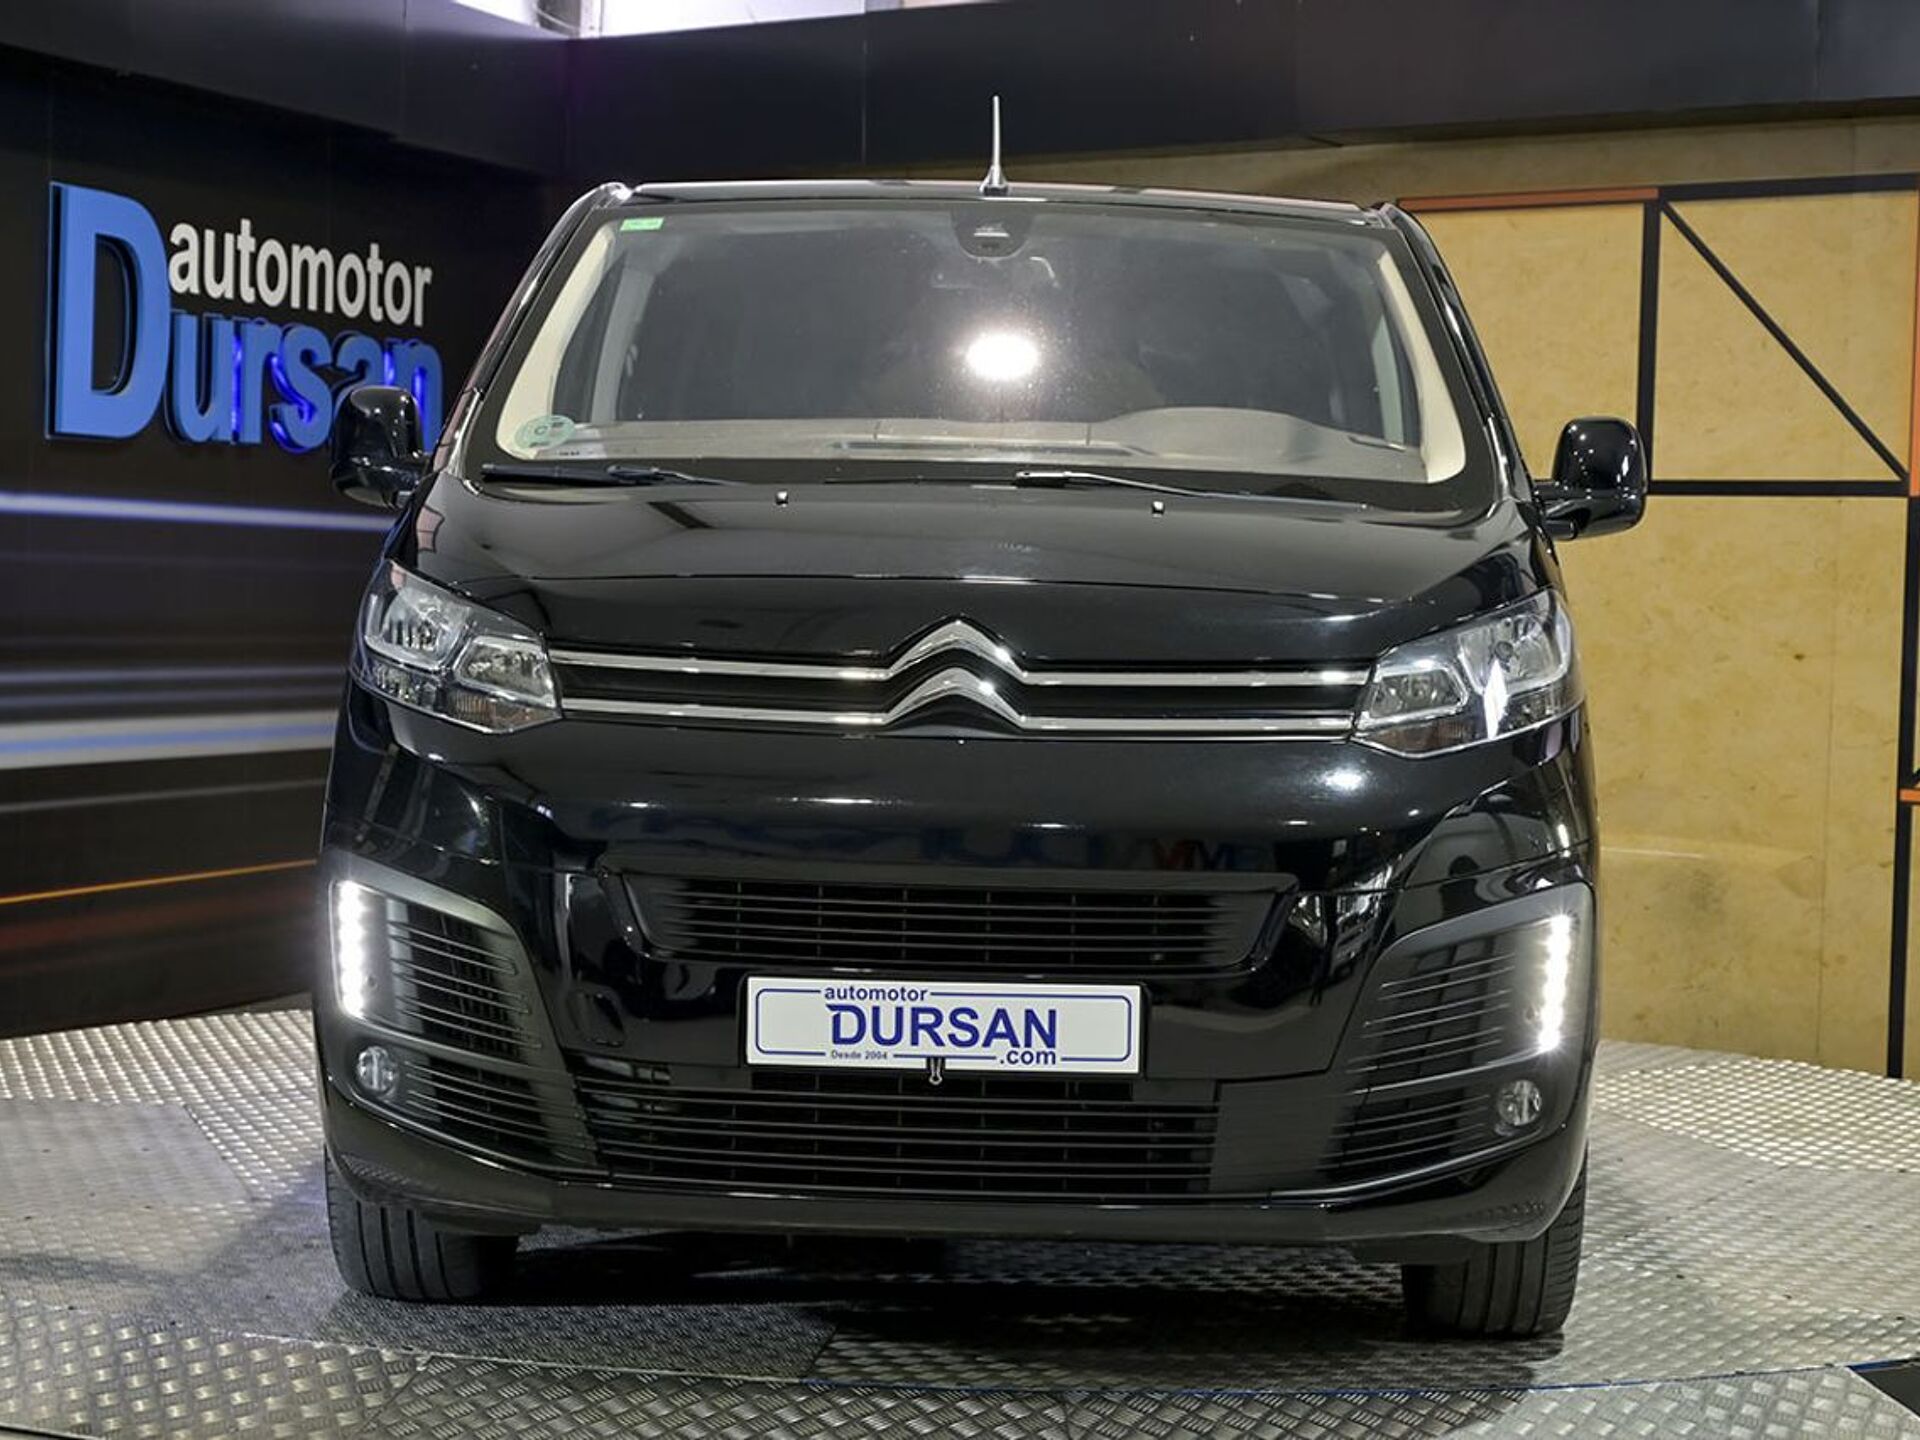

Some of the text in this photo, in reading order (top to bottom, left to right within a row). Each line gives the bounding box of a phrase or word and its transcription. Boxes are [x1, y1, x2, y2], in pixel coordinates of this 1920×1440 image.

[168, 218, 433, 328] automotor
[824, 985, 928, 1001] automotor
[825, 1003, 1057, 1049] DURSAN
[831, 1050, 862, 1060] Desde
[1000, 1049, 1057, 1065] .com
